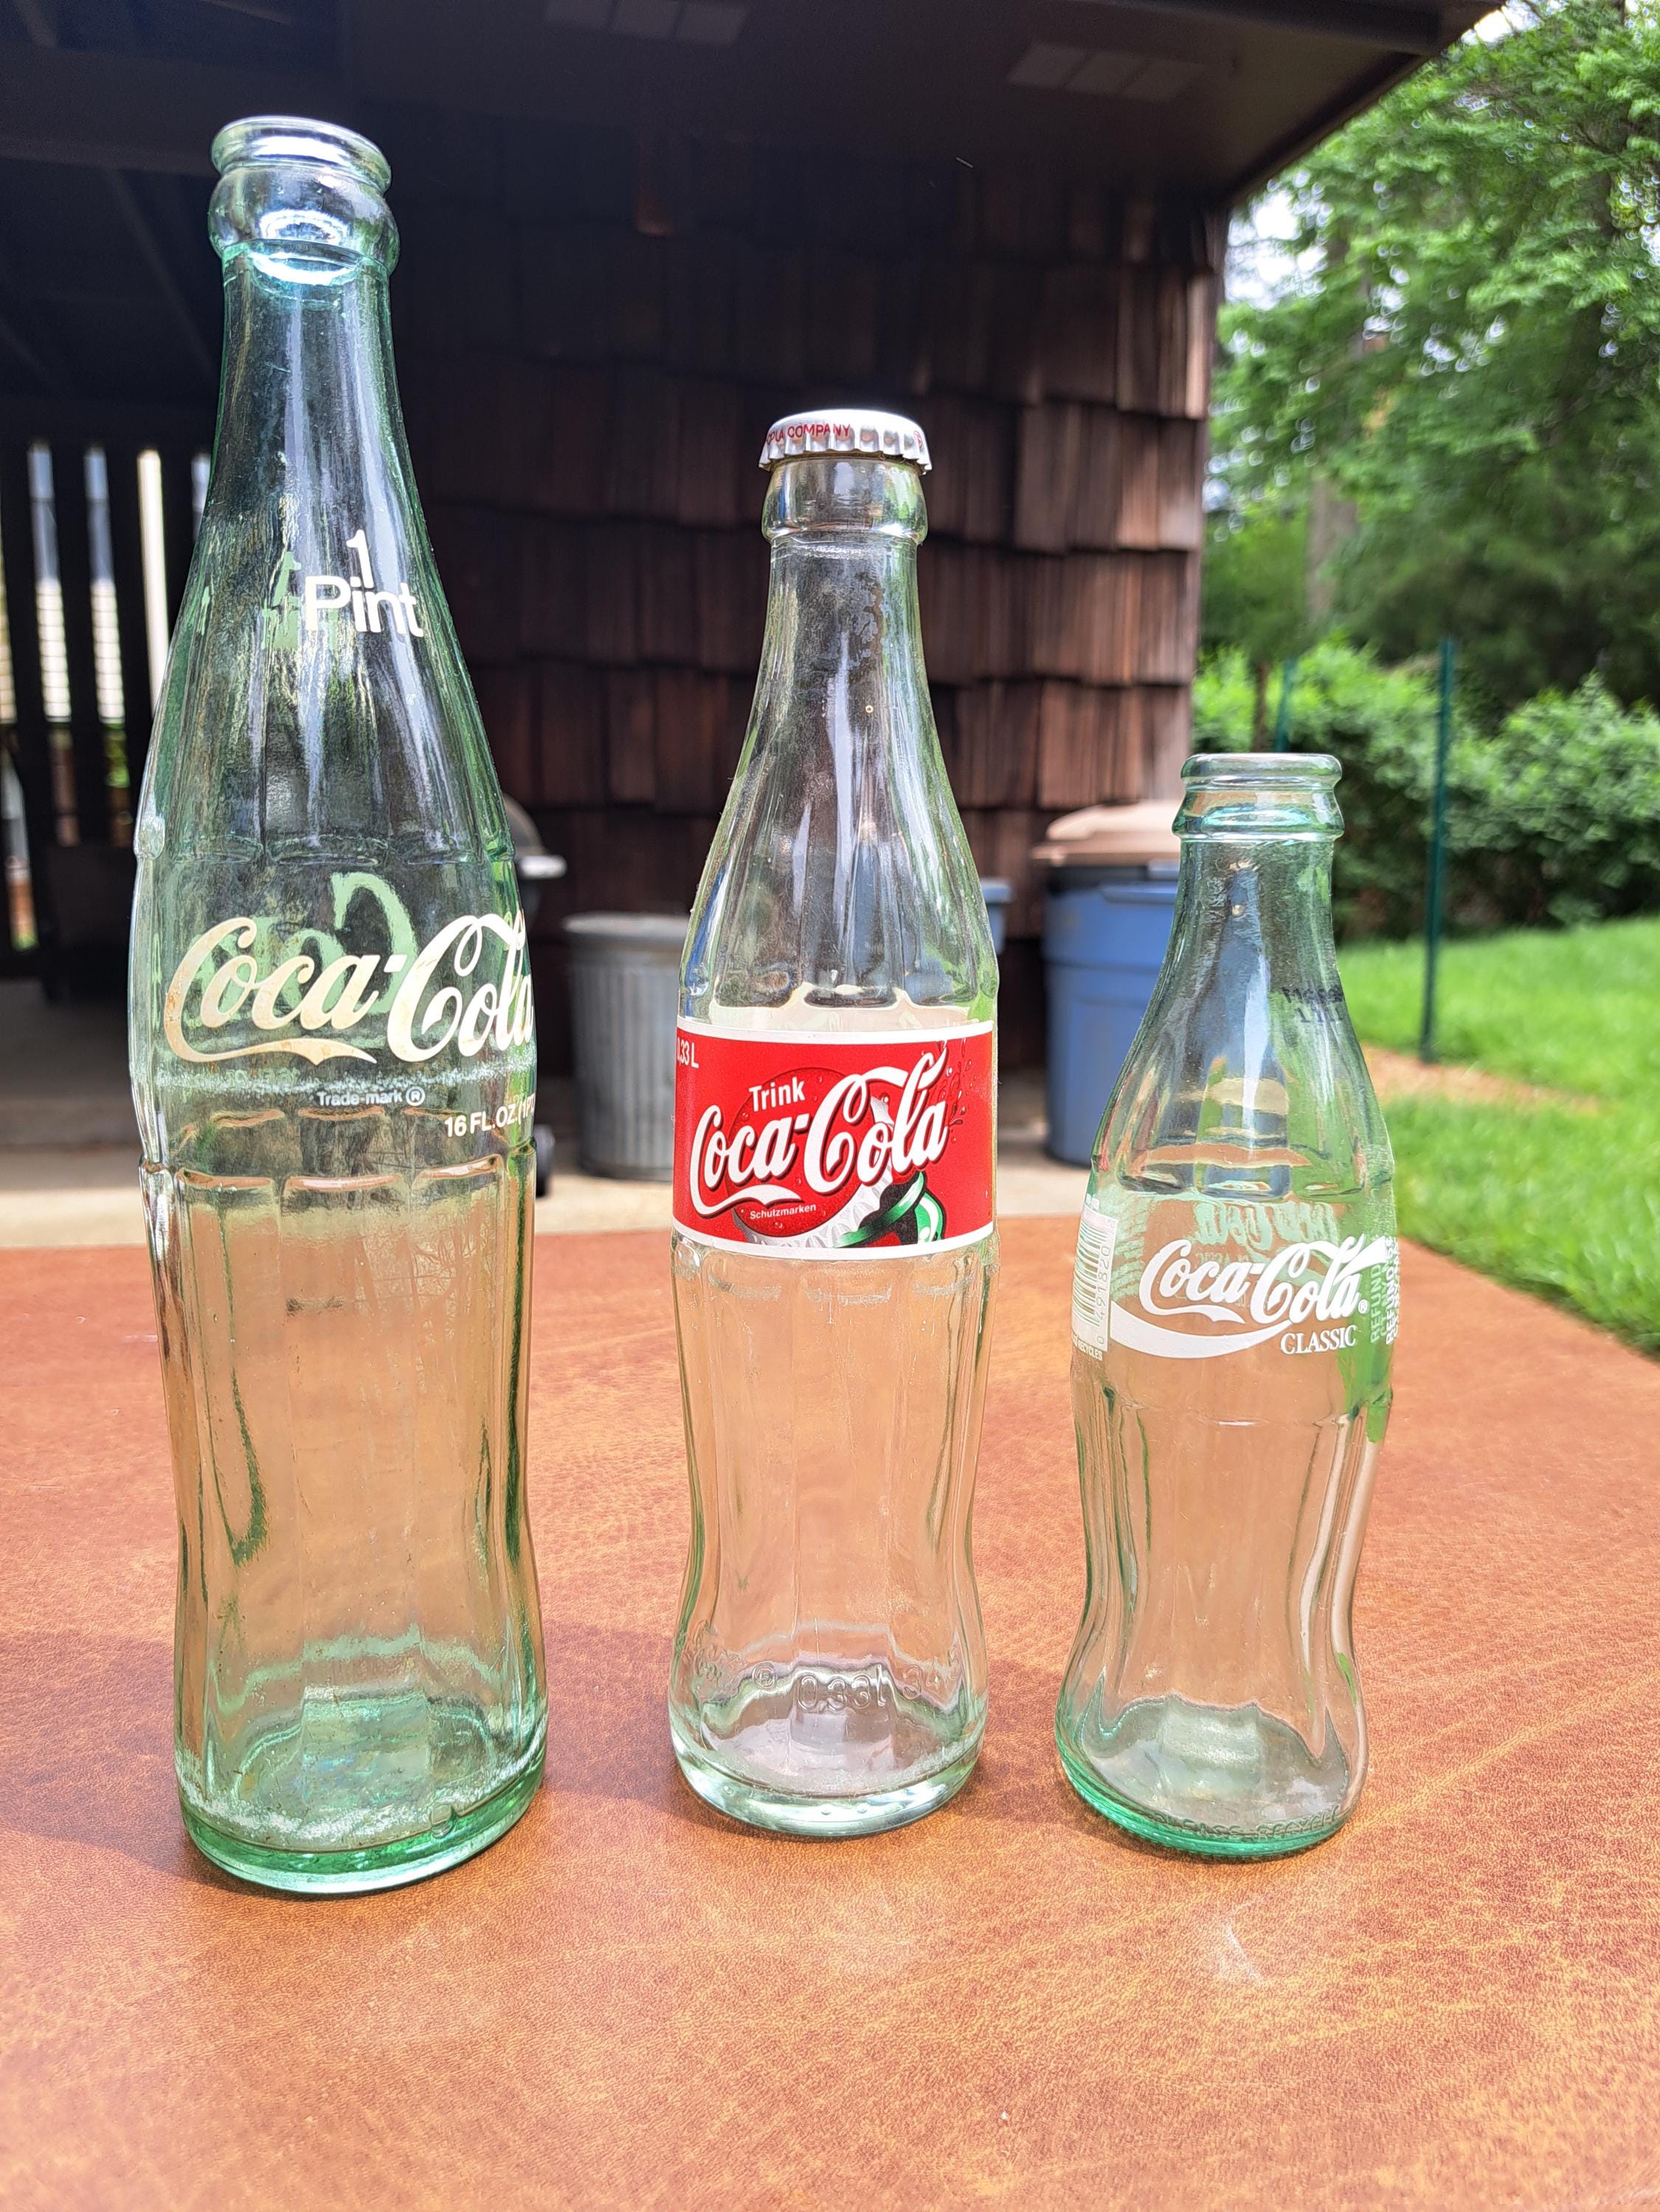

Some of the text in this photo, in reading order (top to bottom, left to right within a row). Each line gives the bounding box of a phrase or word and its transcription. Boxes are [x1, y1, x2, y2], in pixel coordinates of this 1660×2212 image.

[786, 423, 851, 438] COMPANY
[345, 529, 375, 589] 1
[303, 575, 425, 637] Pint
[164, 911, 534, 1065] Coca-Cola
[691, 1041, 699, 1069] L
[316, 1089, 403, 1106] Trade-mark
[748, 1077, 806, 1113] Trink
[444, 1114, 467, 1137] 16
[691, 1040, 950, 1217] Coca-Cola
[749, 1203, 817, 1221] Schutzmarken
[1279, 1325, 1358, 1356] CLASSIC
